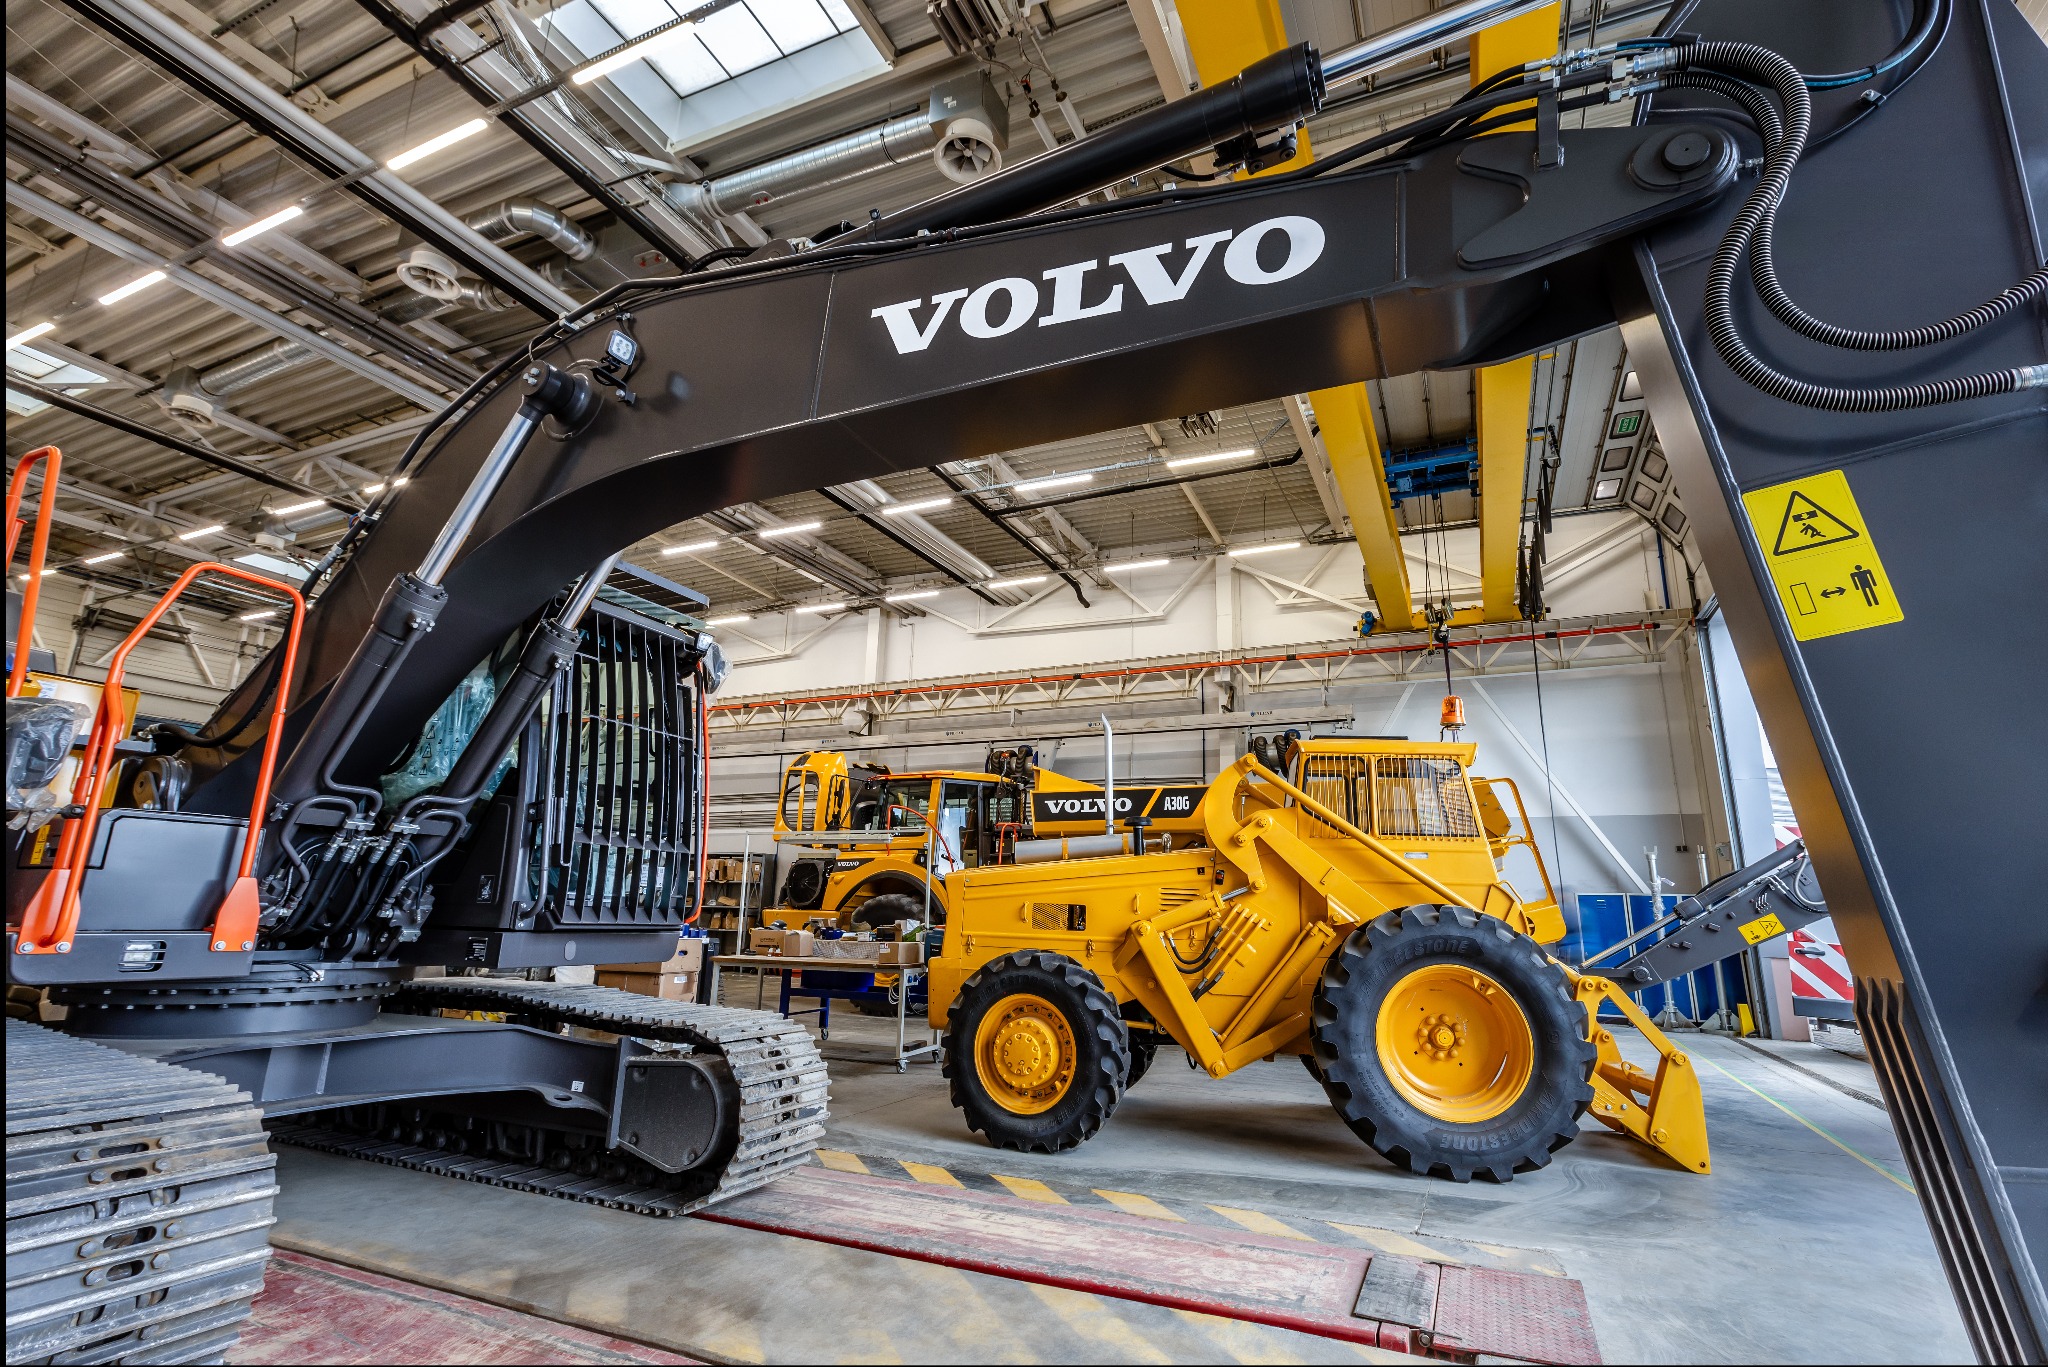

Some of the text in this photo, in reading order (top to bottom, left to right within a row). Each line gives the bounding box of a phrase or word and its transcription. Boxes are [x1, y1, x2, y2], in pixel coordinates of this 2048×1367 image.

[871, 215, 1326, 355] VOLVO
[1045, 797, 1133, 814] VOLVO
[1163, 796, 1190, 811] A30G
[1439, 1089, 1556, 1151] BRIDGESTONE
